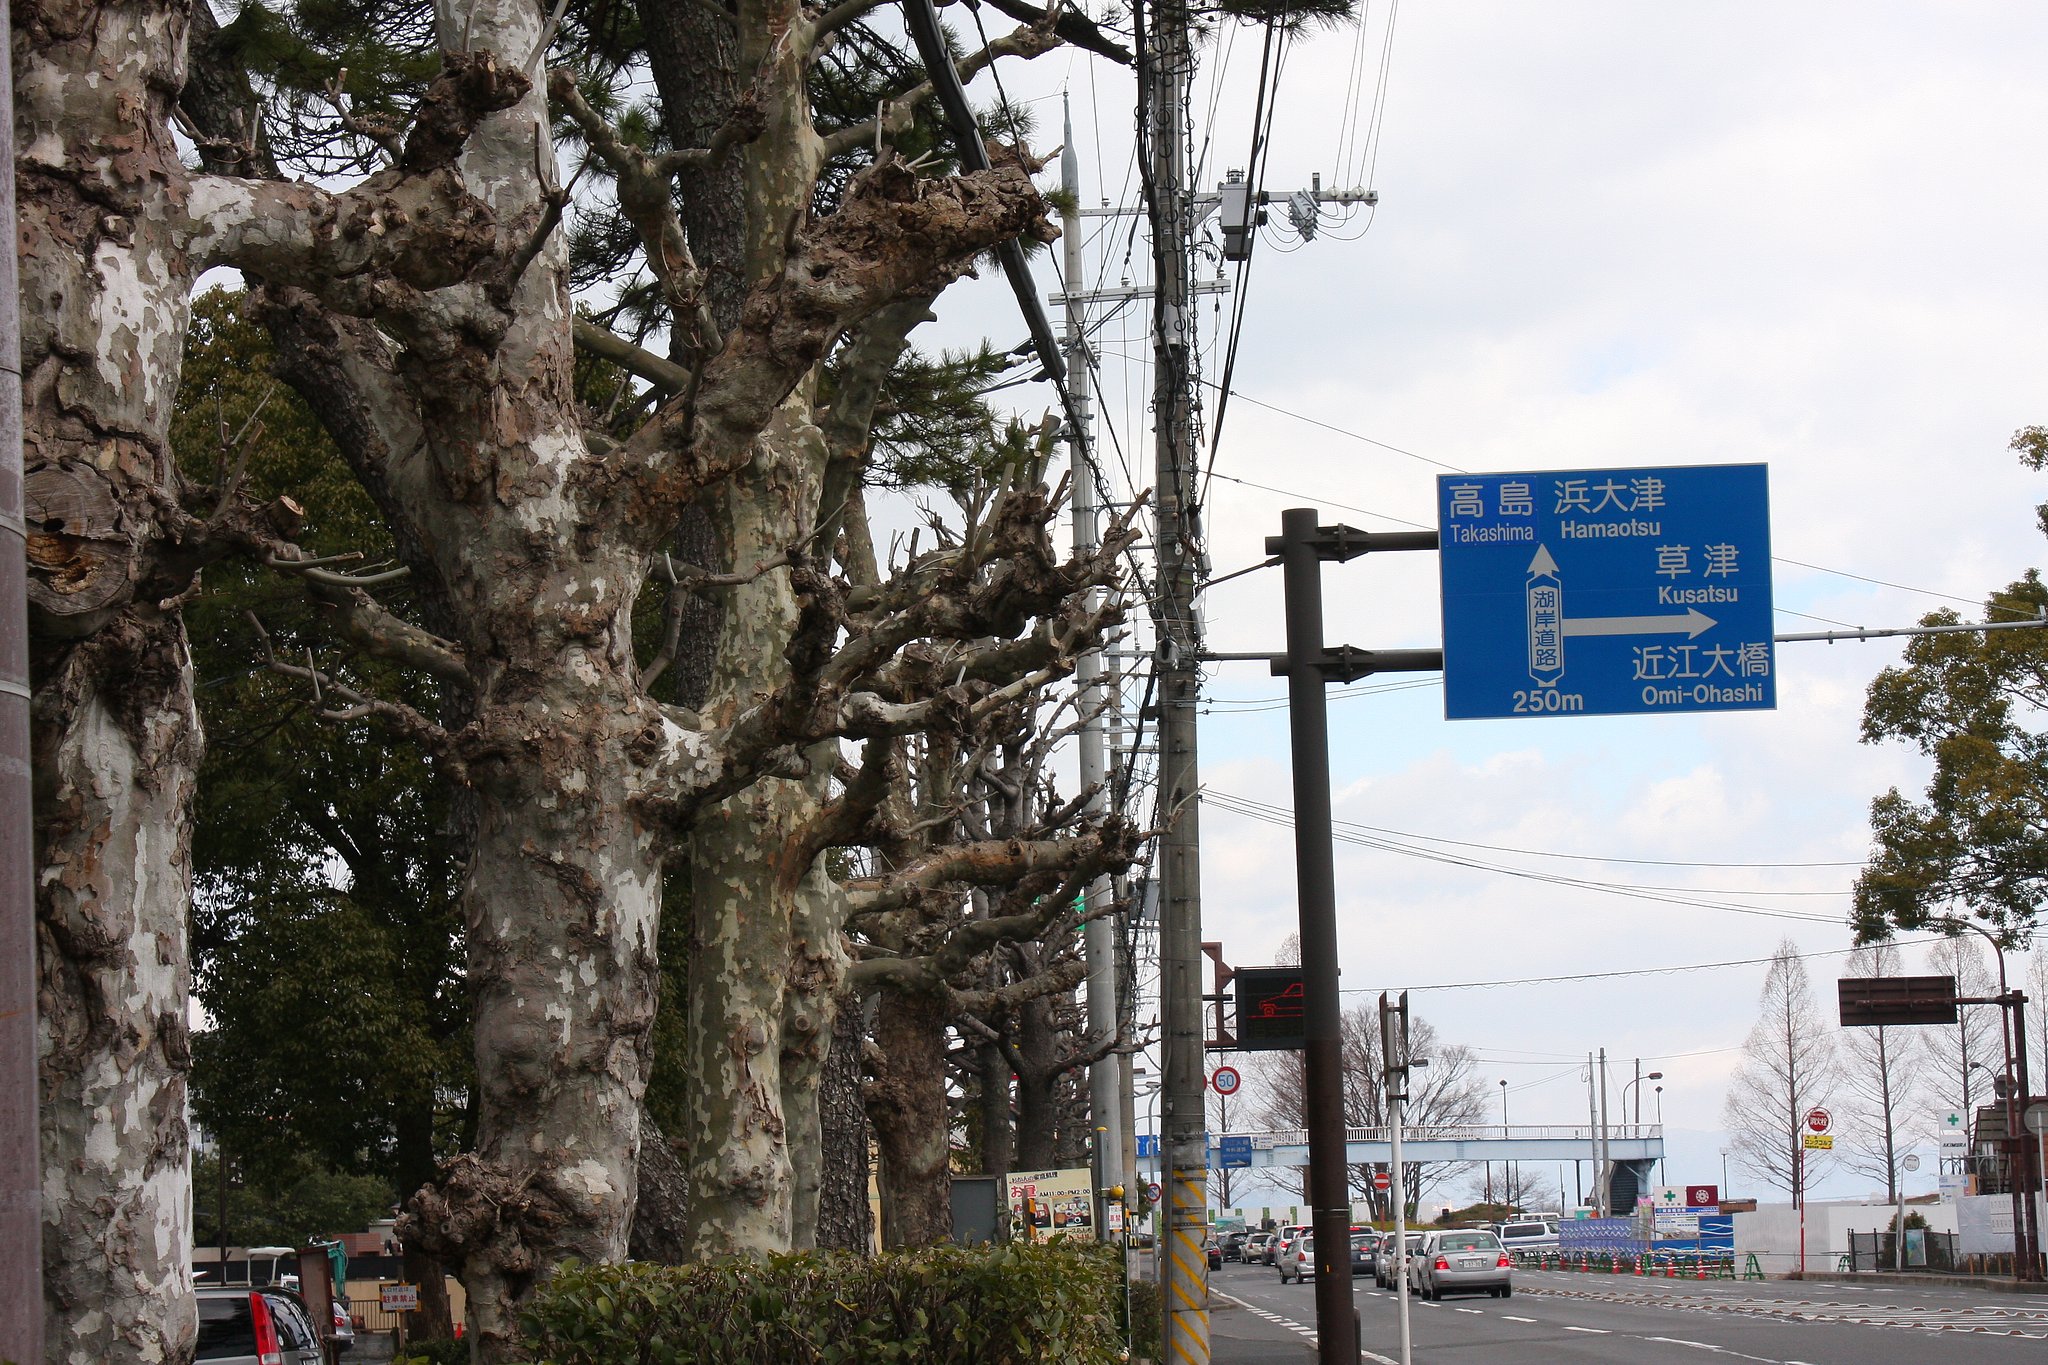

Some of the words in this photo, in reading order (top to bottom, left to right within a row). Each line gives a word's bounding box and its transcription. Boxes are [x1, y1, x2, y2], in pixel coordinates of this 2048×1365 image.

[1449, 481, 1533, 518] 高島
[1554, 476, 1666, 514] 浜大津
[1450, 523, 1534, 543] Takashima
[1560, 518, 1661, 539] Hamaotsu
[1655, 543, 1740, 579] 草津
[1658, 584, 1738, 605] Kusatsu
[1533, 590, 1556, 667] 湖岸道路
[1632, 642, 1770, 682] 近江大橋
[1512, 690, 1584, 713] 250m
[1641, 683, 1763, 705] Omi-Ohashi
[1218, 1074, 1235, 1088] 50
